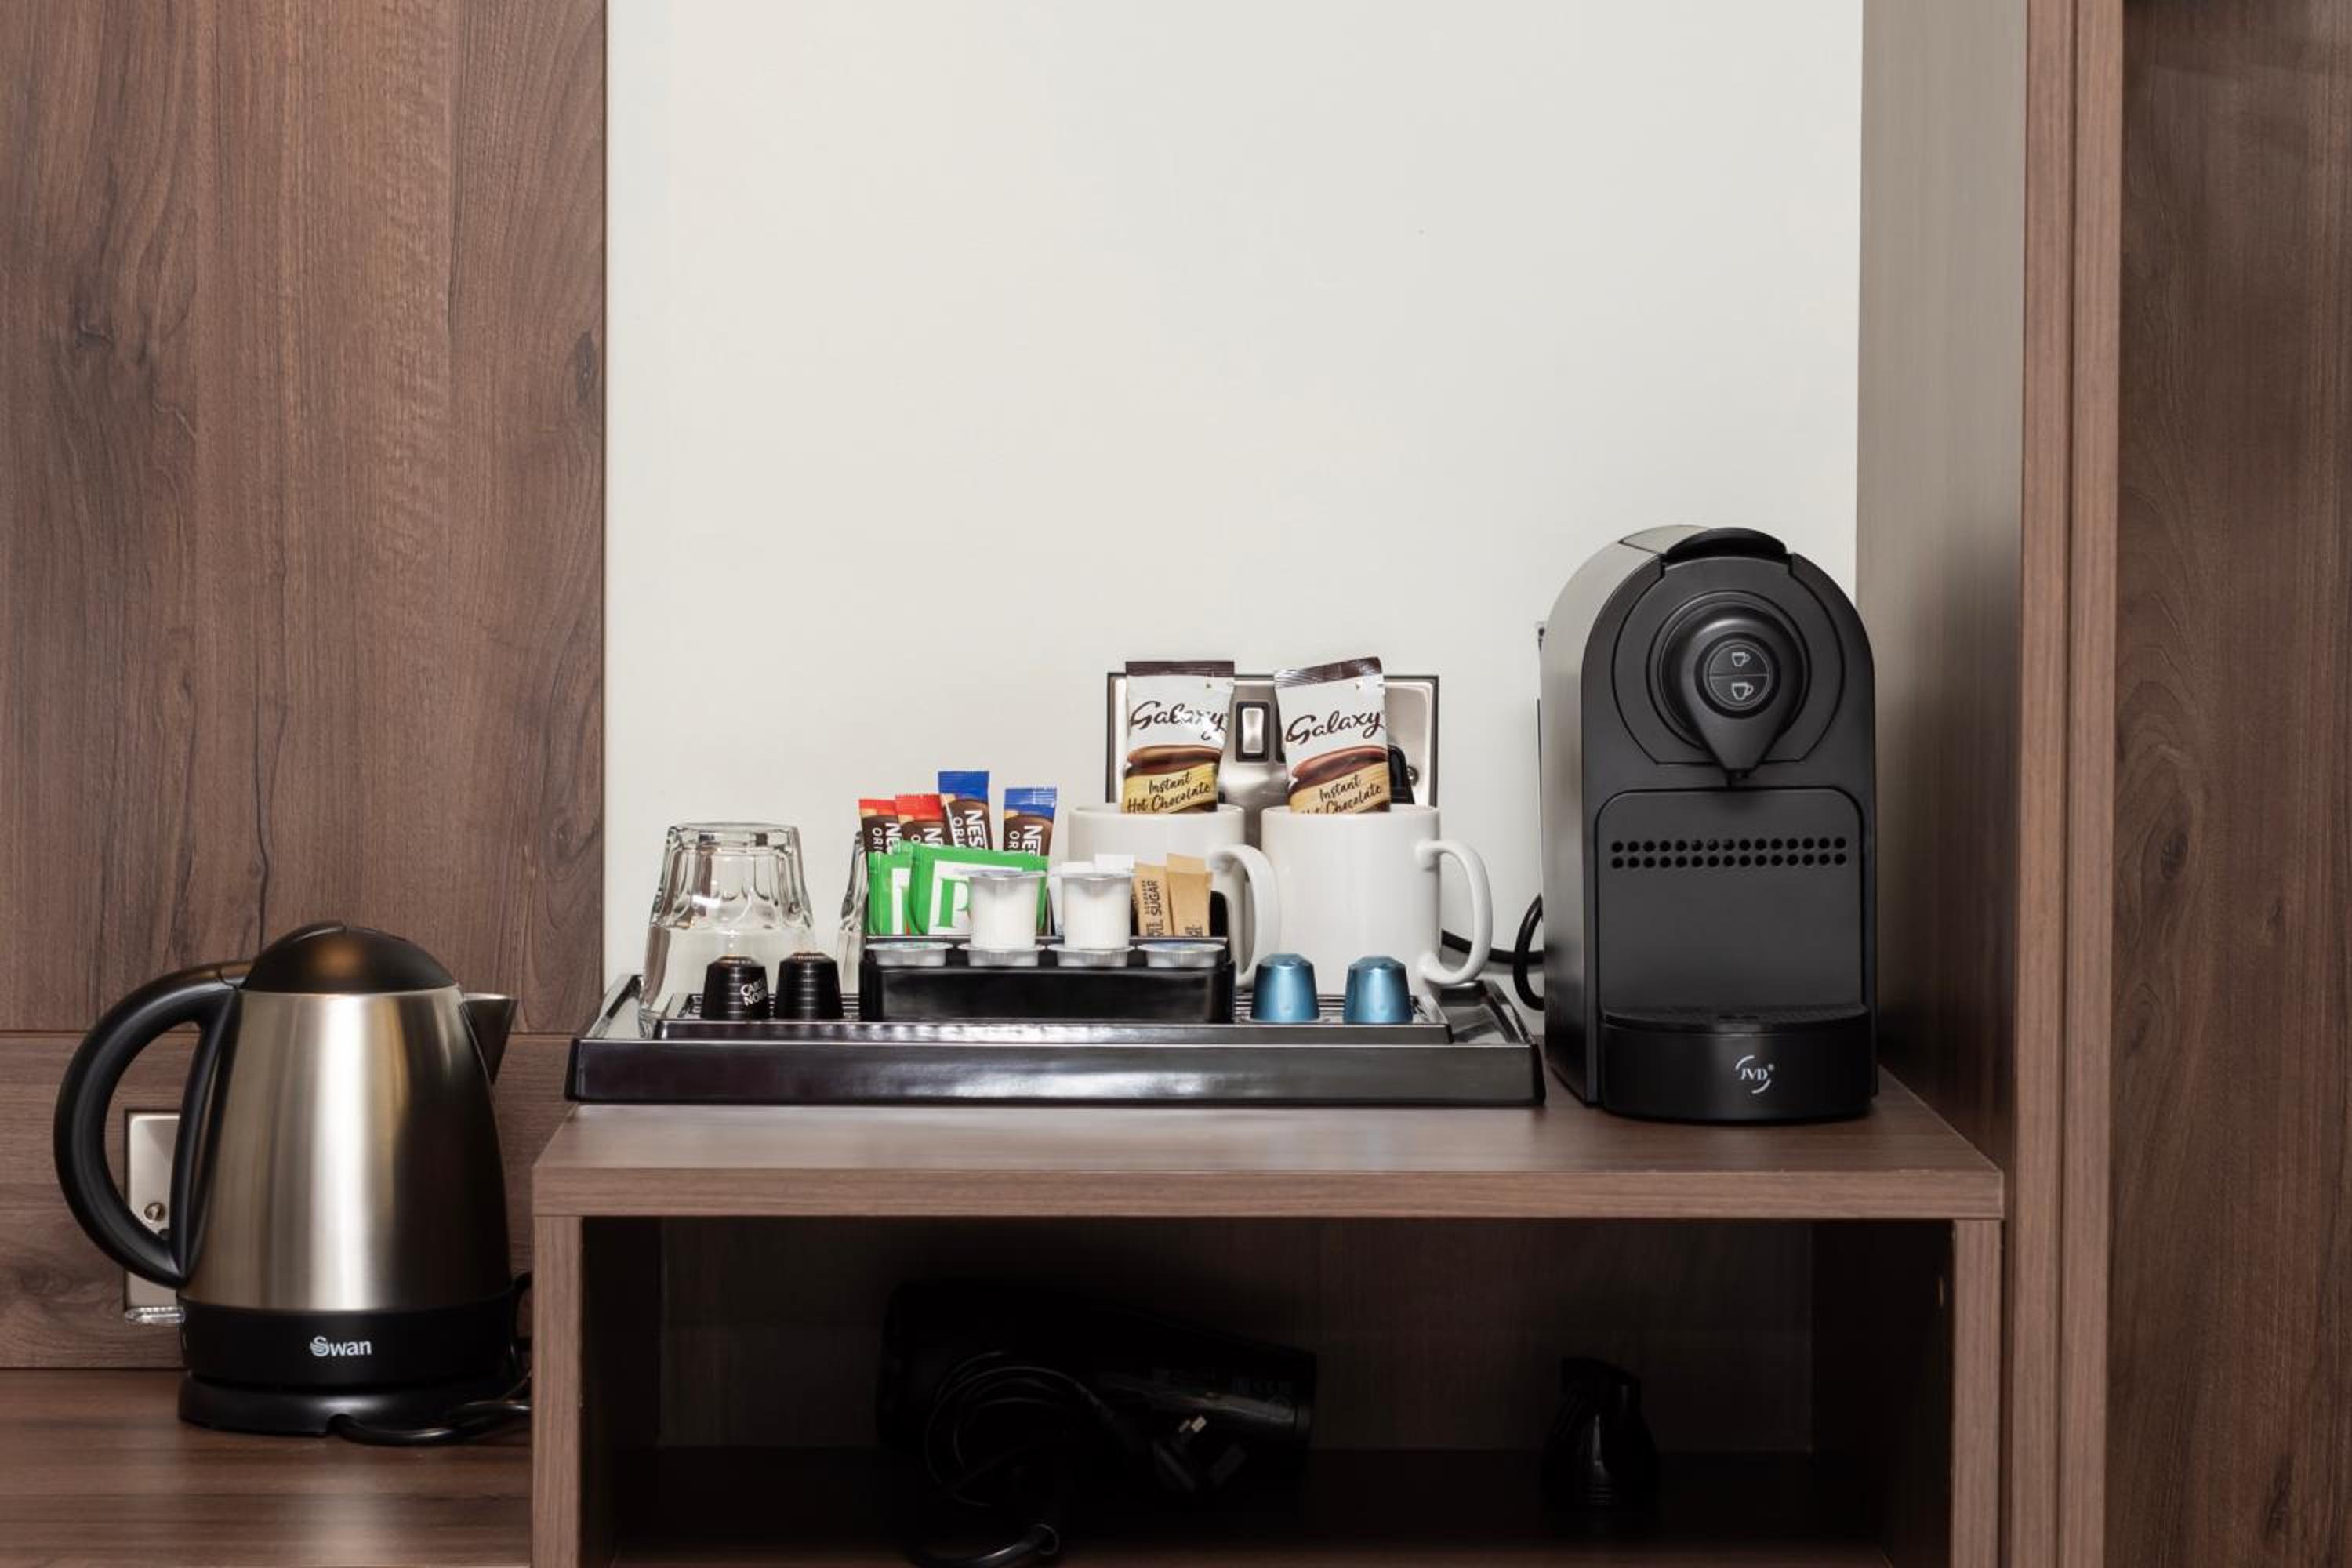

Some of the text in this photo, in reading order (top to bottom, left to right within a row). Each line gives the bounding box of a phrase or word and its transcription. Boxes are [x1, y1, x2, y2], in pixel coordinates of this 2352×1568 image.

[1286, 710, 1385, 744] Galaxy
[1149, 771, 1192, 794] Instant
[1319, 775, 1360, 801] Instant
[1127, 782, 1212, 813] Hot Chocolate
[1147, 880, 1162, 916] SUGAR
[310, 1336, 372, 1357] Swan
